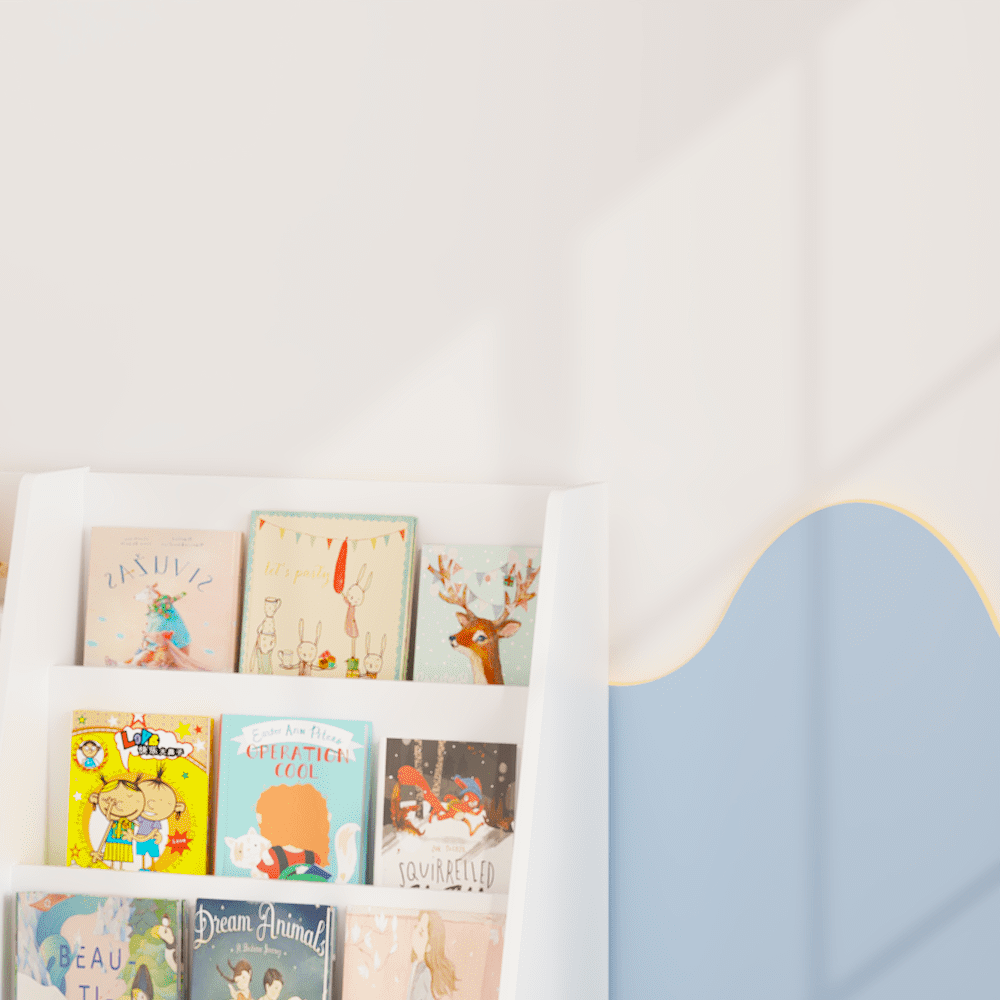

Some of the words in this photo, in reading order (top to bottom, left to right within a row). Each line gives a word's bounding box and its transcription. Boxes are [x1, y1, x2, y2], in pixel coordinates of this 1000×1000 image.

[246, 743, 349, 764] OPERATION
[274, 762, 319, 779] COOL
[399, 858, 495, 889] SQUIRRELLED
[193, 903, 254, 950] Dream
[256, 901, 327, 957] Animals
[59, 944, 137, 971] BEAU-
